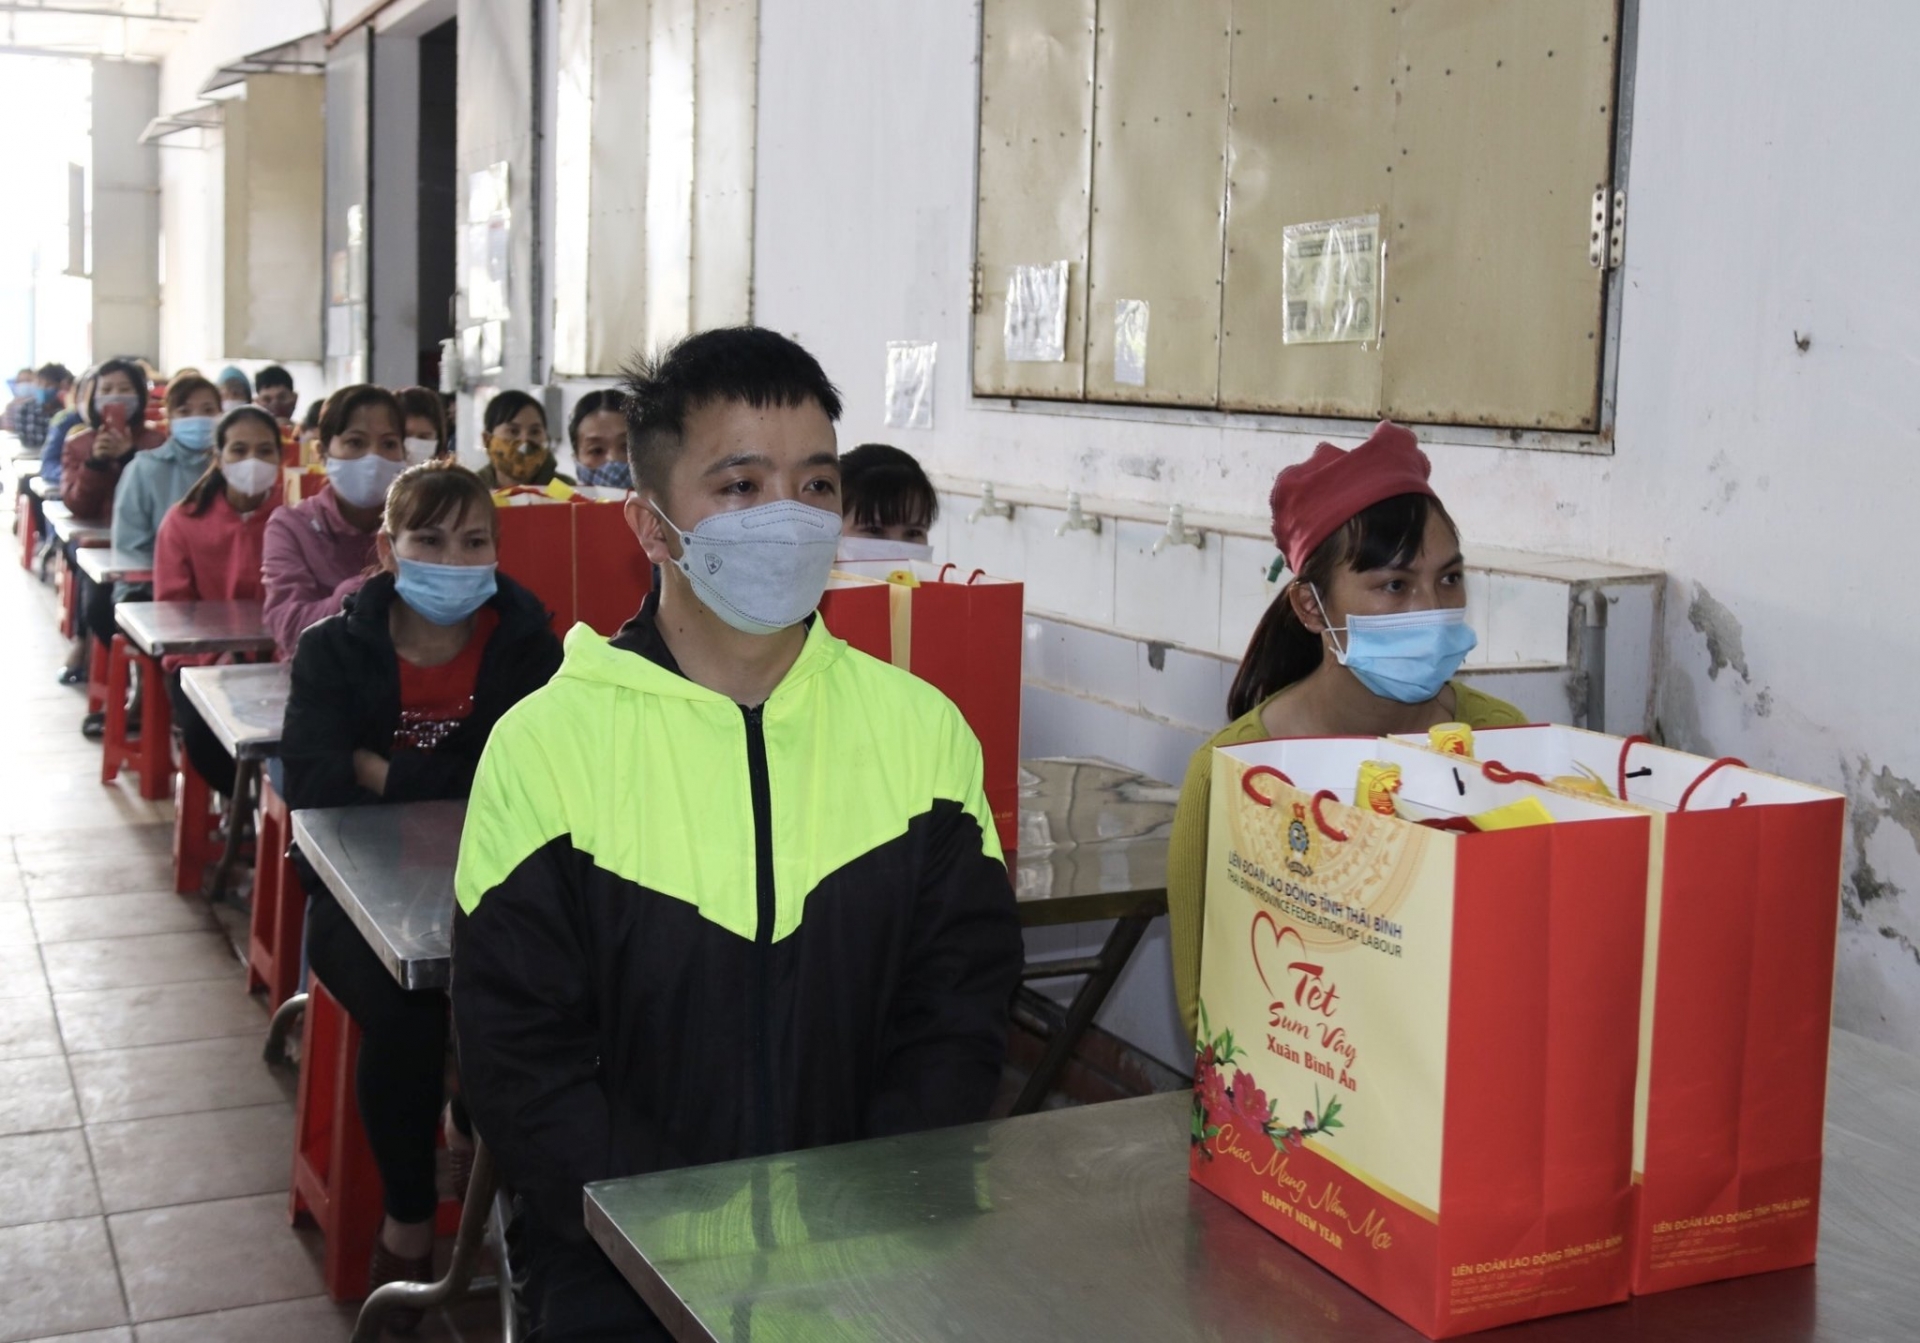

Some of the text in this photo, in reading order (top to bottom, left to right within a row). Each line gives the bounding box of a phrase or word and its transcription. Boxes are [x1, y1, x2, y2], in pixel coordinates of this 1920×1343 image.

[1267, 873, 1283, 893] LAO
[1256, 886, 1290, 914] PROVINCE
[1291, 904, 1344, 936] FEDERATION
[1346, 926, 1360, 941] OF
[1361, 931, 1402, 958] LABOUR
[1268, 1001, 1310, 1040] Sum
[1266, 1032, 1300, 1065] Xuân
[1338, 1068, 1357, 1092] An
[1261, 1189, 1343, 1250] HAPPY NEW YEAR
[1704, 1214, 1724, 1226] LAO
[1451, 1263, 1473, 1277] LIÊN
[1509, 1256, 1530, 1269] LAO
